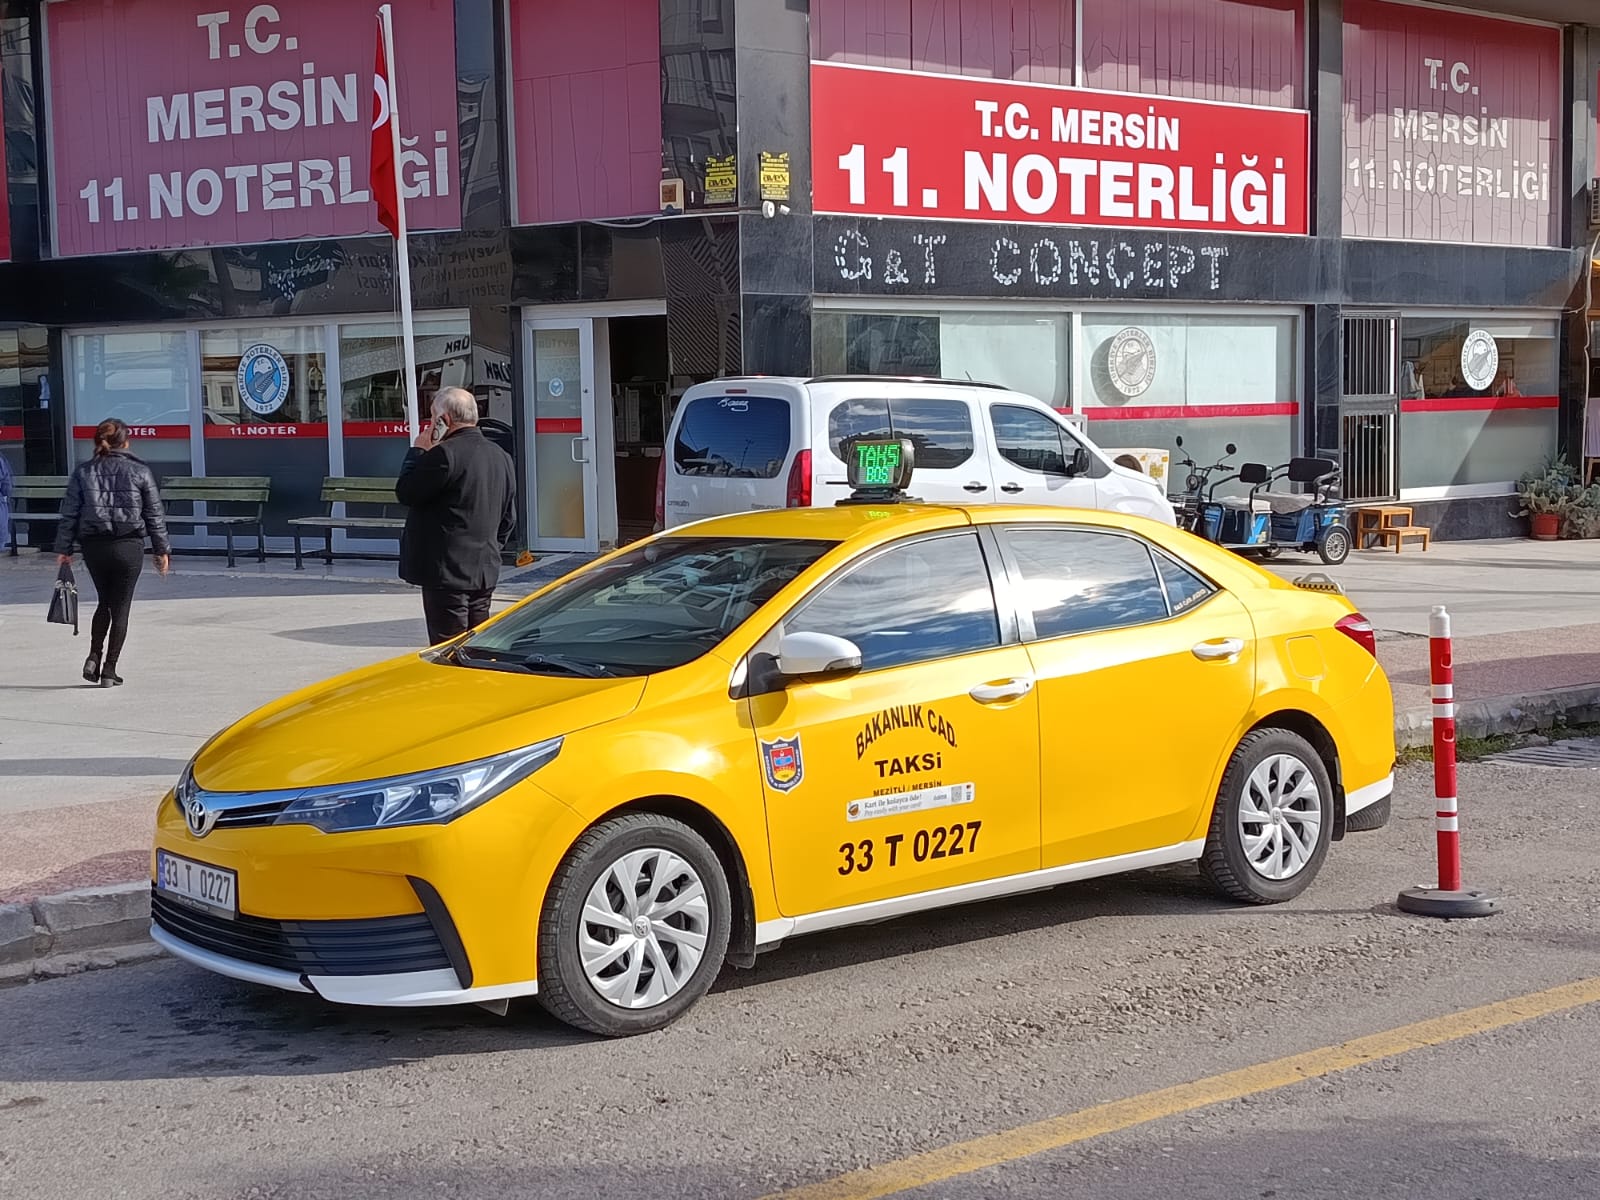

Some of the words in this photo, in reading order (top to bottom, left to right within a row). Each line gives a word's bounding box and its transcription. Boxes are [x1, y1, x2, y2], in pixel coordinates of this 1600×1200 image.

[197, 4, 298, 60] T.C.
[146, 62, 359, 143] MERSİN
[1424, 57, 1479, 95] T.C.
[975, 100, 1038, 140] T.C.
[1051, 106, 1180, 152] MERSİN
[1393, 107, 1508, 149] MERSİN
[79, 177, 139, 224] 11.
[149, 130, 449, 219] NOTERLĞİ
[837, 144, 938, 209] 11.
[964, 152, 1286, 226] NOTERLİĞİ
[1348, 158, 1384, 190] 11.
[1392, 160, 1548, 201] NOTERLİĞİ
[991, 236, 1229, 290] CONCEPT
[856, 704, 924, 760] BAKANLIK
[928, 709, 958, 748] CAD.
[873, 784, 905, 796] MEZİTLİ
[912, 779, 942, 791] MERSİN
[838, 839, 873, 876] 33
[885, 834, 904, 867] T
[913, 820, 982, 862] 0227
[165, 858, 178, 888] 33
[185, 864, 192, 893] T
[200, 869, 231, 904] 0227
